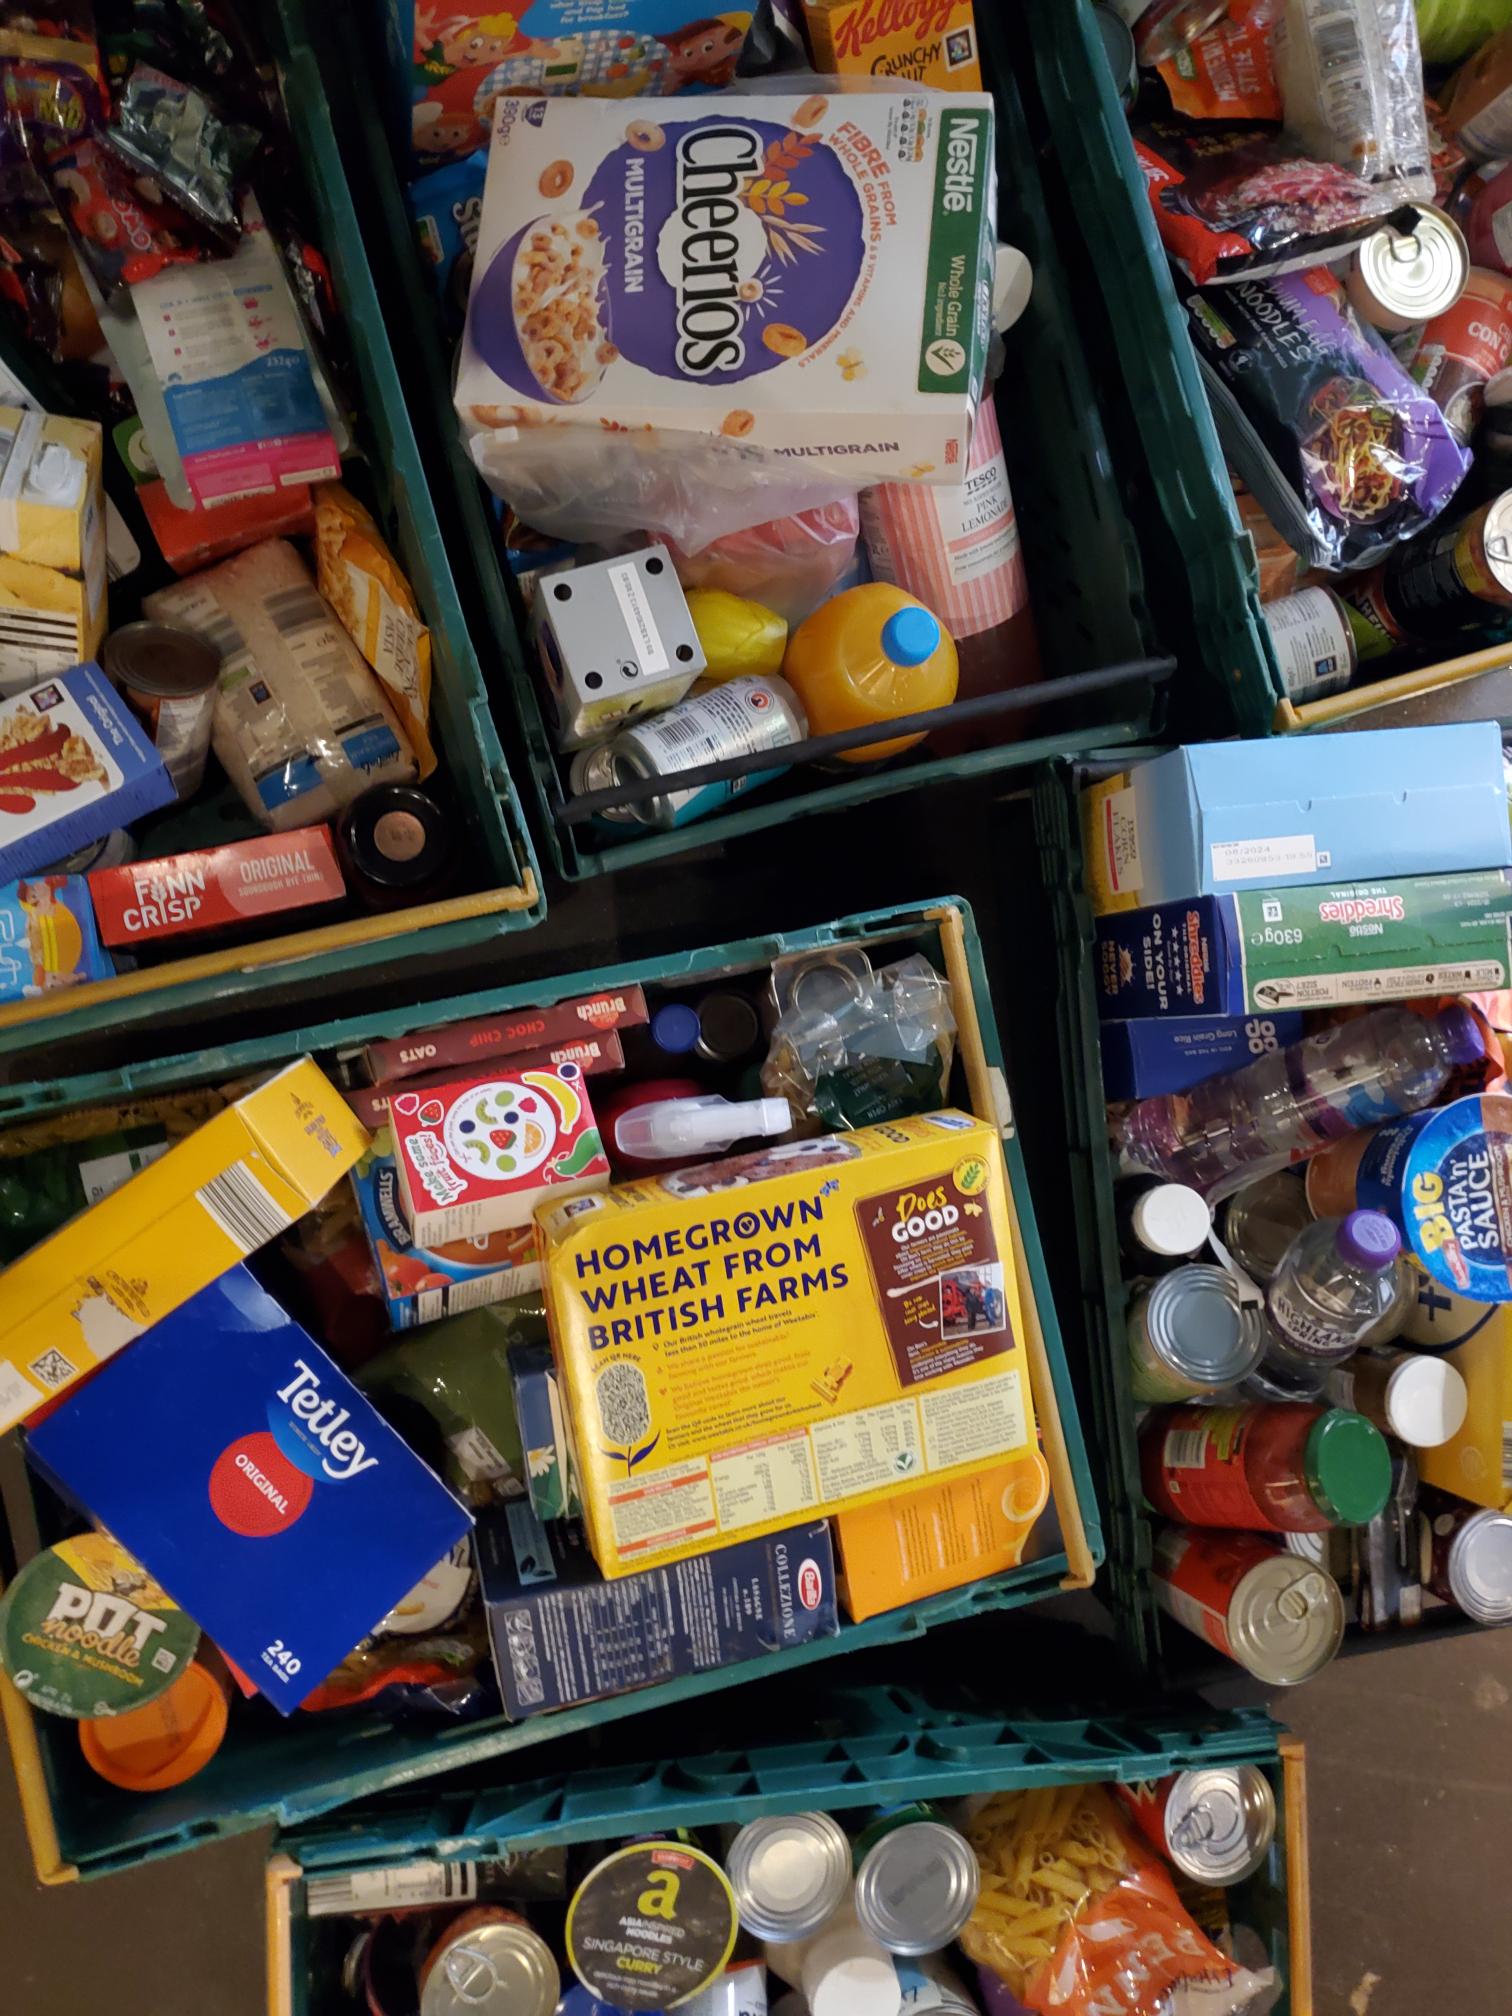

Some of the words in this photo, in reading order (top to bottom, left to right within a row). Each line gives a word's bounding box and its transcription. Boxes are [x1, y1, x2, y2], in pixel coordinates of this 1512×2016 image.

[835, 0, 972, 58] Kellogg
[829, 134, 868, 180] WHOLE
[863, 183, 882, 241] GRAINS
[836, 122, 890, 178] FIBRE
[878, 181, 897, 226] FROM
[624, 158, 645, 294] MULTIGRAIN
[681, 128, 758, 373] Cheerios
[949, 255, 965, 298] Whole
[946, 301, 962, 337] Grain
[1235, 282, 1312, 361] NOODLES
[1296, 318, 1338, 356] EGG
[1468, 321, 1500, 346] CON
[773, 442, 899, 458] MULTIGRAIN
[965, 466, 997, 492] TESCO
[976, 496, 998, 514] PINK
[240, 850, 315, 885] ORIGINAL
[1318, 896, 1405, 921] Shreddies
[1330, 890, 1367, 899] ORIGINAL
[123, 897, 202, 932] CRISP
[1152, 913, 1162, 945] ON
[1265, 927, 1303, 946] 630g
[1108, 940, 1118, 994] NEVER
[1142, 936, 1155, 990] SIDE!
[1183, 945, 1192, 994] ORIGINAL
[1186, 911, 1205, 1004] Shreddies
[1155, 951, 1168, 1010] YOUR
[576, 997, 627, 1021] Brunch
[469, 1029, 500, 1047] CHIP
[504, 1020, 545, 1038] CHOC
[1173, 1034, 1191, 1044] Rice
[1192, 1031, 1215, 1043] Grain
[400, 1044, 436, 1063] OATS
[550, 1042, 601, 1064] Brunch
[409, 1138, 428, 1168] some
[424, 1171, 452, 1201] Make
[437, 1167, 462, 1192] fruit
[897, 1186, 948, 1222] Does
[1413, 1170, 1457, 1254] BIG
[1468, 1150, 1499, 1249] SAUCE
[575, 1195, 824, 1279] HOMEGROWN
[891, 1204, 959, 1243] GOOD
[580, 1260, 710, 1313] WHEAT
[724, 1233, 821, 1280] FROM
[588, 1294, 725, 1351] BRITISH
[737, 1263, 849, 1313] FARMS
[664, 1339, 678, 1348] Our
[679, 1331, 703, 1344] British
[704, 1321, 745, 1339] wholegrain
[746, 1316, 767, 1328] wheat
[768, 1309, 792, 1321] travels
[665, 1348, 678, 1357] less
[679, 1344, 696, 1354] than
[709, 1336, 728, 1346] miles
[739, 1330, 750, 1339] the
[752, 1325, 772, 1336] home
[276, 1359, 379, 1480] Tetley
[234, 1454, 289, 1515] ORIGINAL
[774, 1542, 797, 1640] COLLEZIONE
[47, 1582, 168, 1650] POT
[41, 1617, 140, 1667] noodle
[267, 1639, 301, 1676] 240
[583, 1936, 660, 1963] SINGAPORE
[663, 1951, 704, 1972] STYLE
[625, 1928, 672, 1945] NOODLES
[616, 1956, 663, 1975] CURRY
